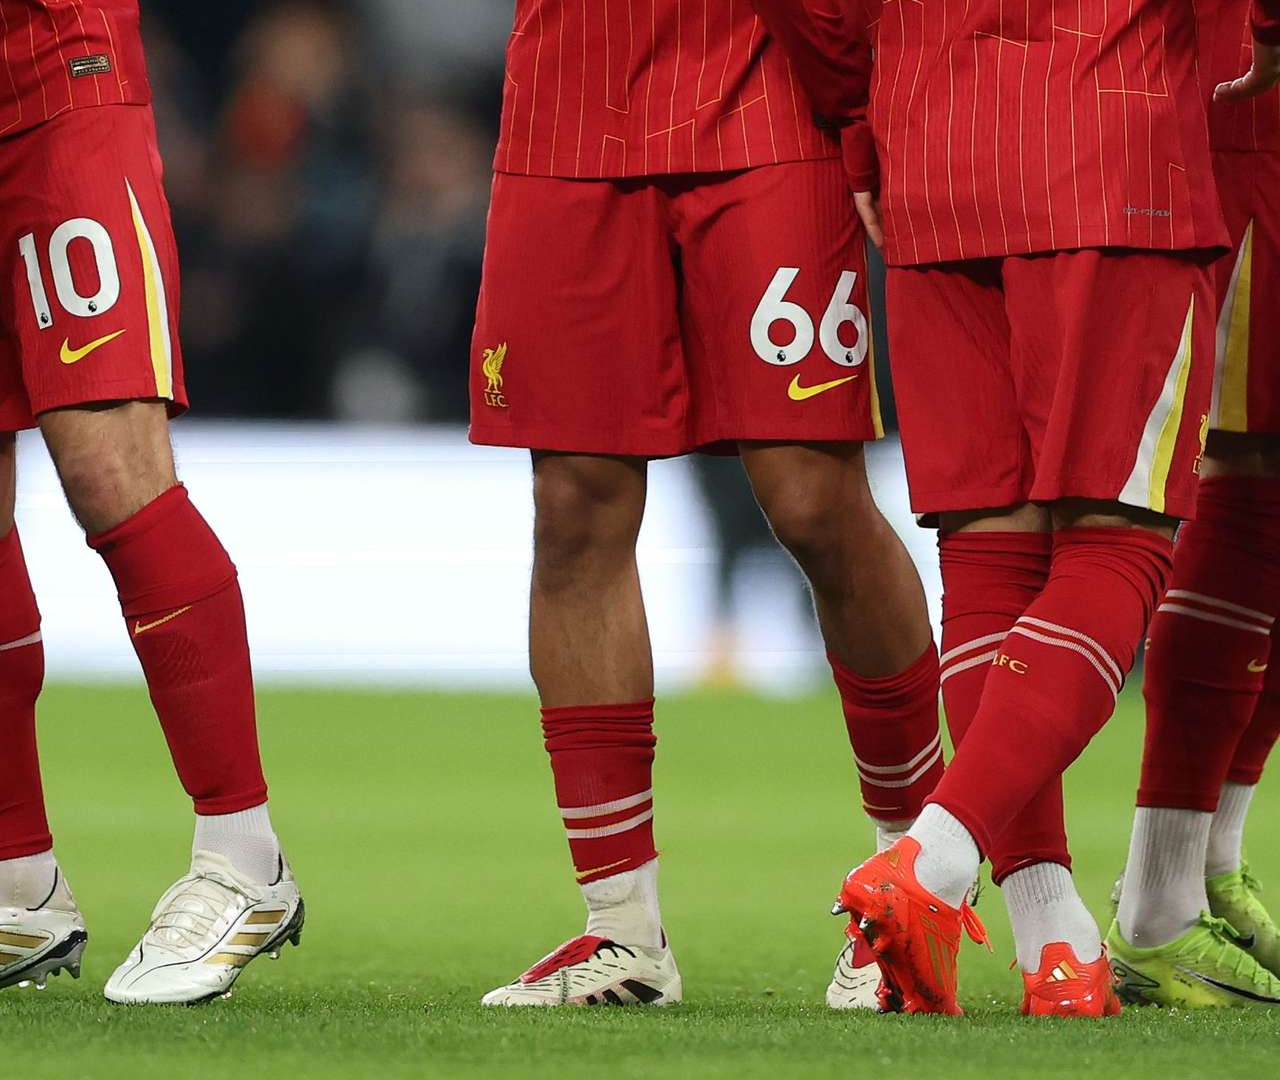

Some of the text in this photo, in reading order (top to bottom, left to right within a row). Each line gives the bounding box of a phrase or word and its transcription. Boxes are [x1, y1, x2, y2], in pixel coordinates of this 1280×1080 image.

[18, 217, 121, 330] 10
[750, 266, 869, 367] 66
[991, 652, 1028, 675] LFC
